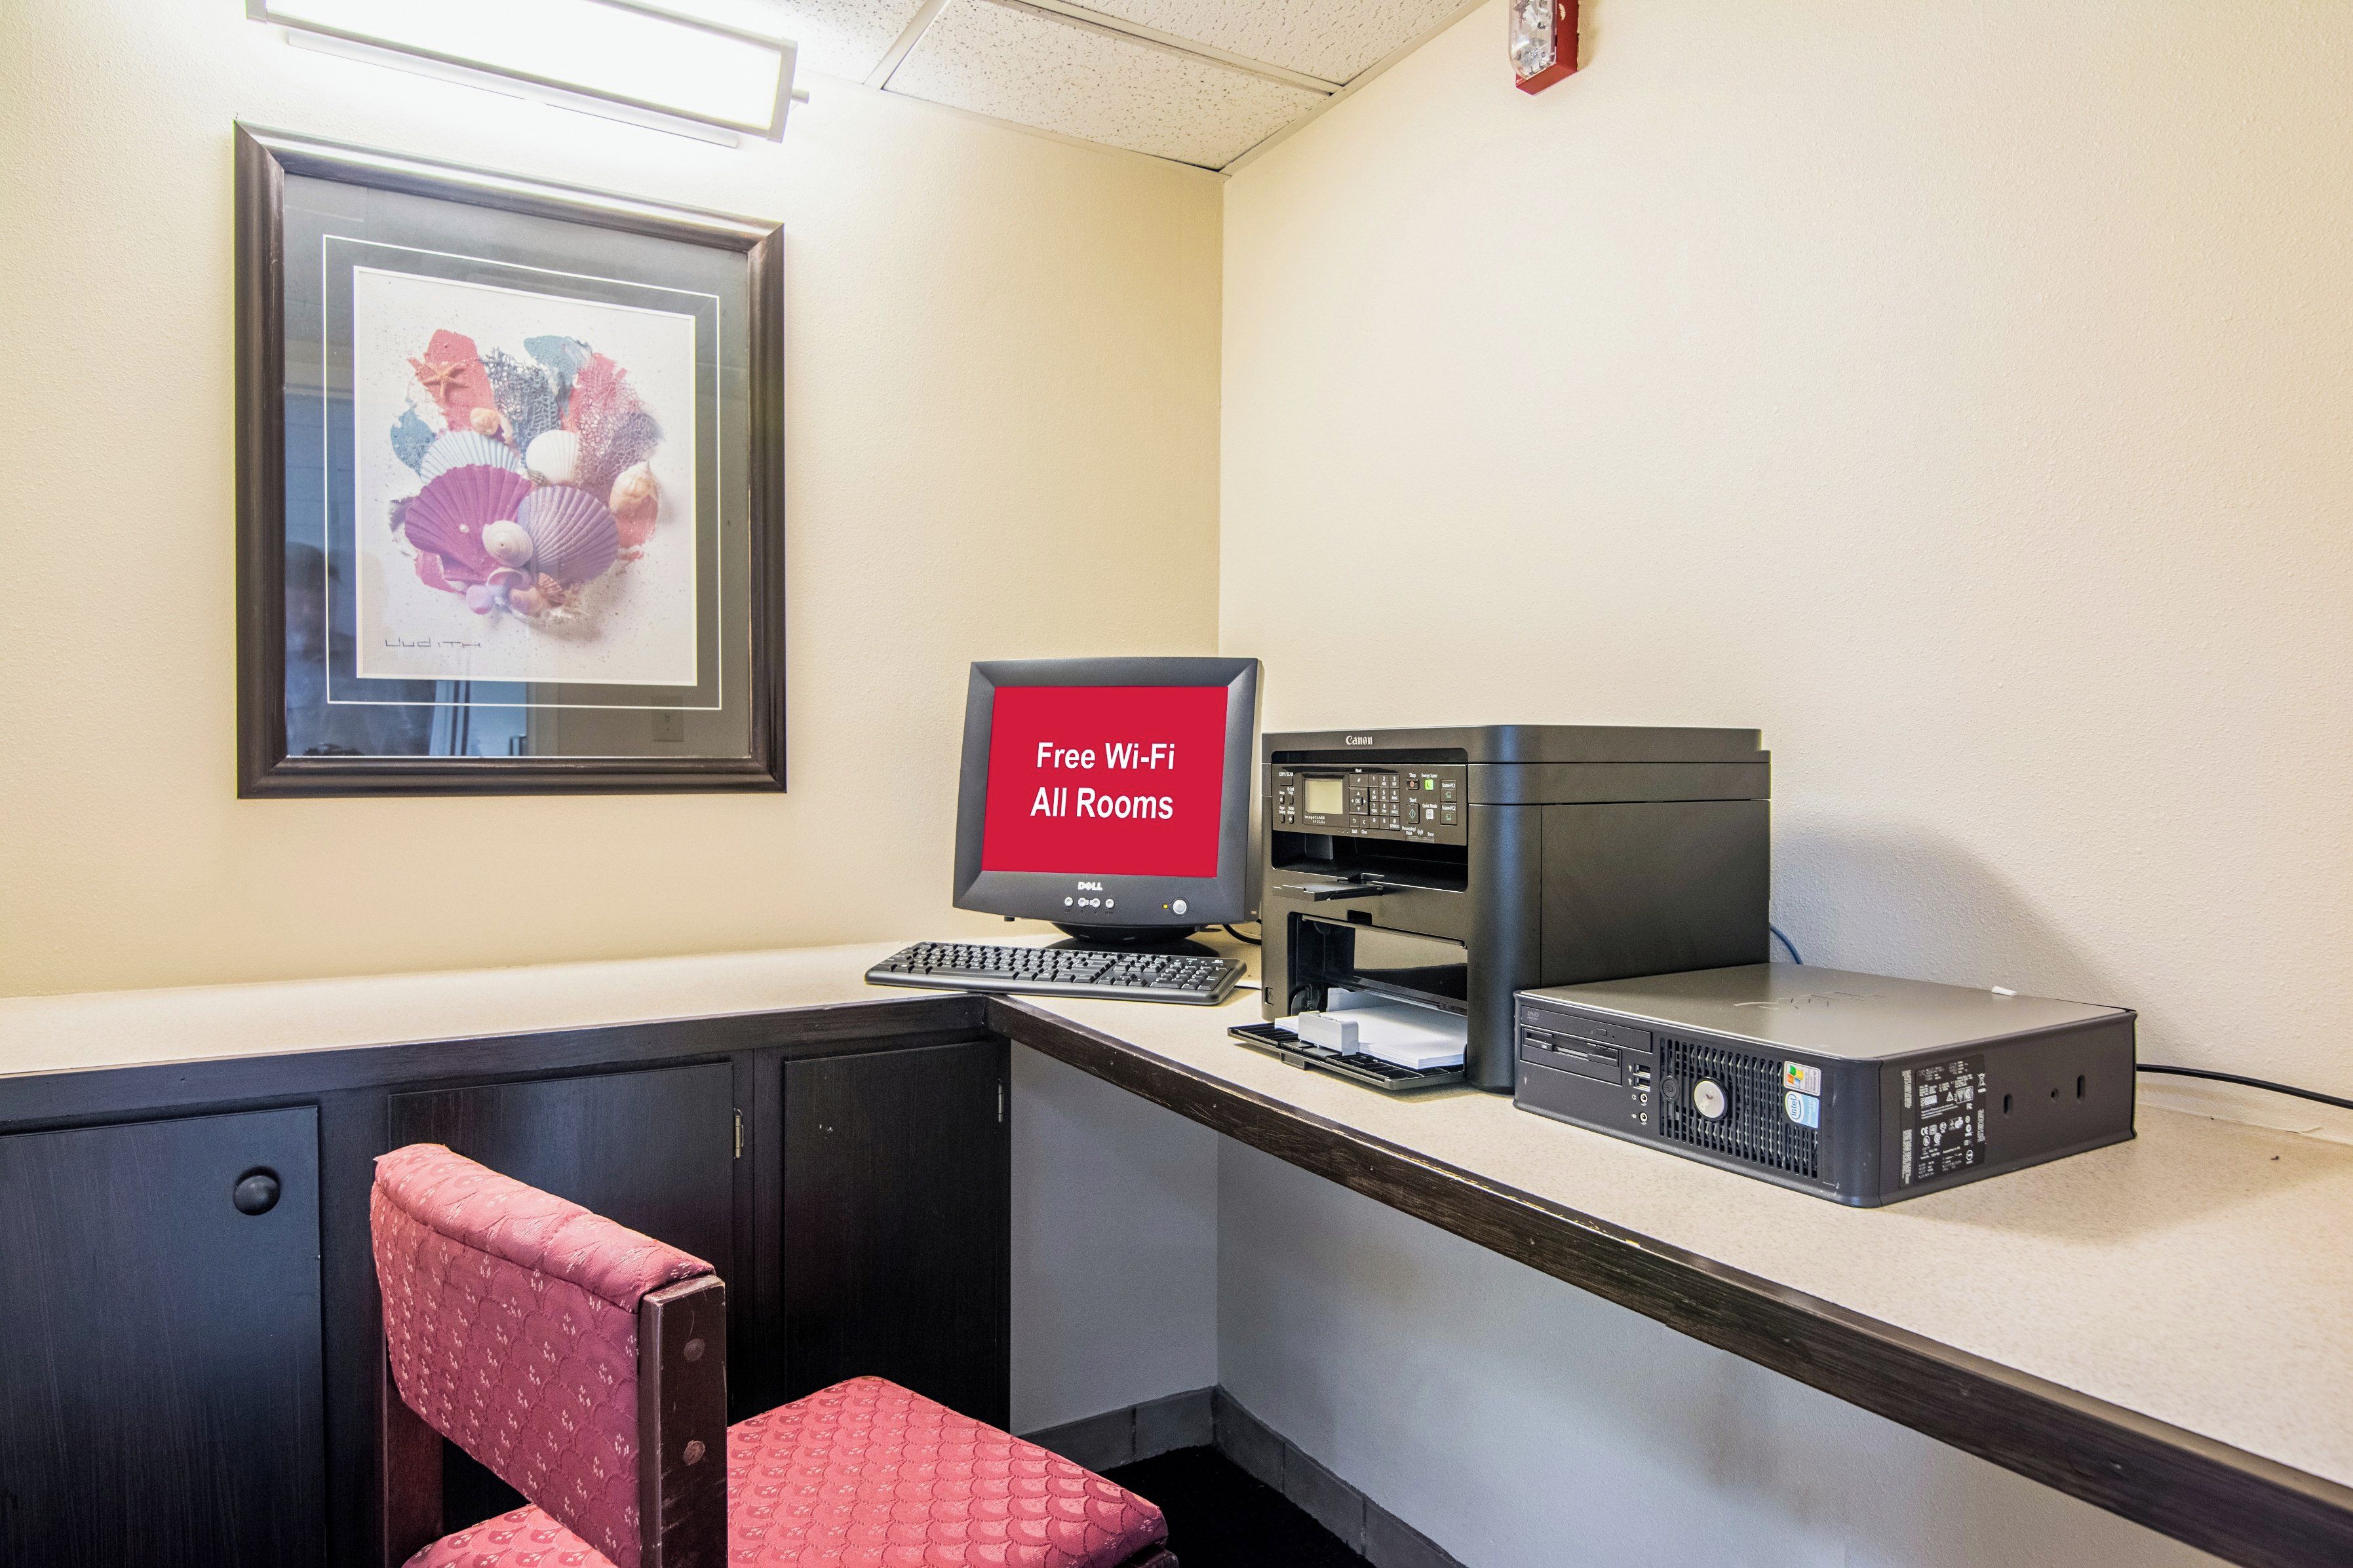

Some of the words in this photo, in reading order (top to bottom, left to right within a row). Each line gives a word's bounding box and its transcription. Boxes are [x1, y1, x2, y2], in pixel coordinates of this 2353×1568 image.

[1346, 735, 1373, 745] Canon
[1036, 742, 1096, 769] Free
[1104, 742, 1175, 770] Wi-Fi
[1030, 786, 1068, 817] All
[1076, 787, 1173, 820] Rooms
[1078, 881, 1102, 890] DELL
